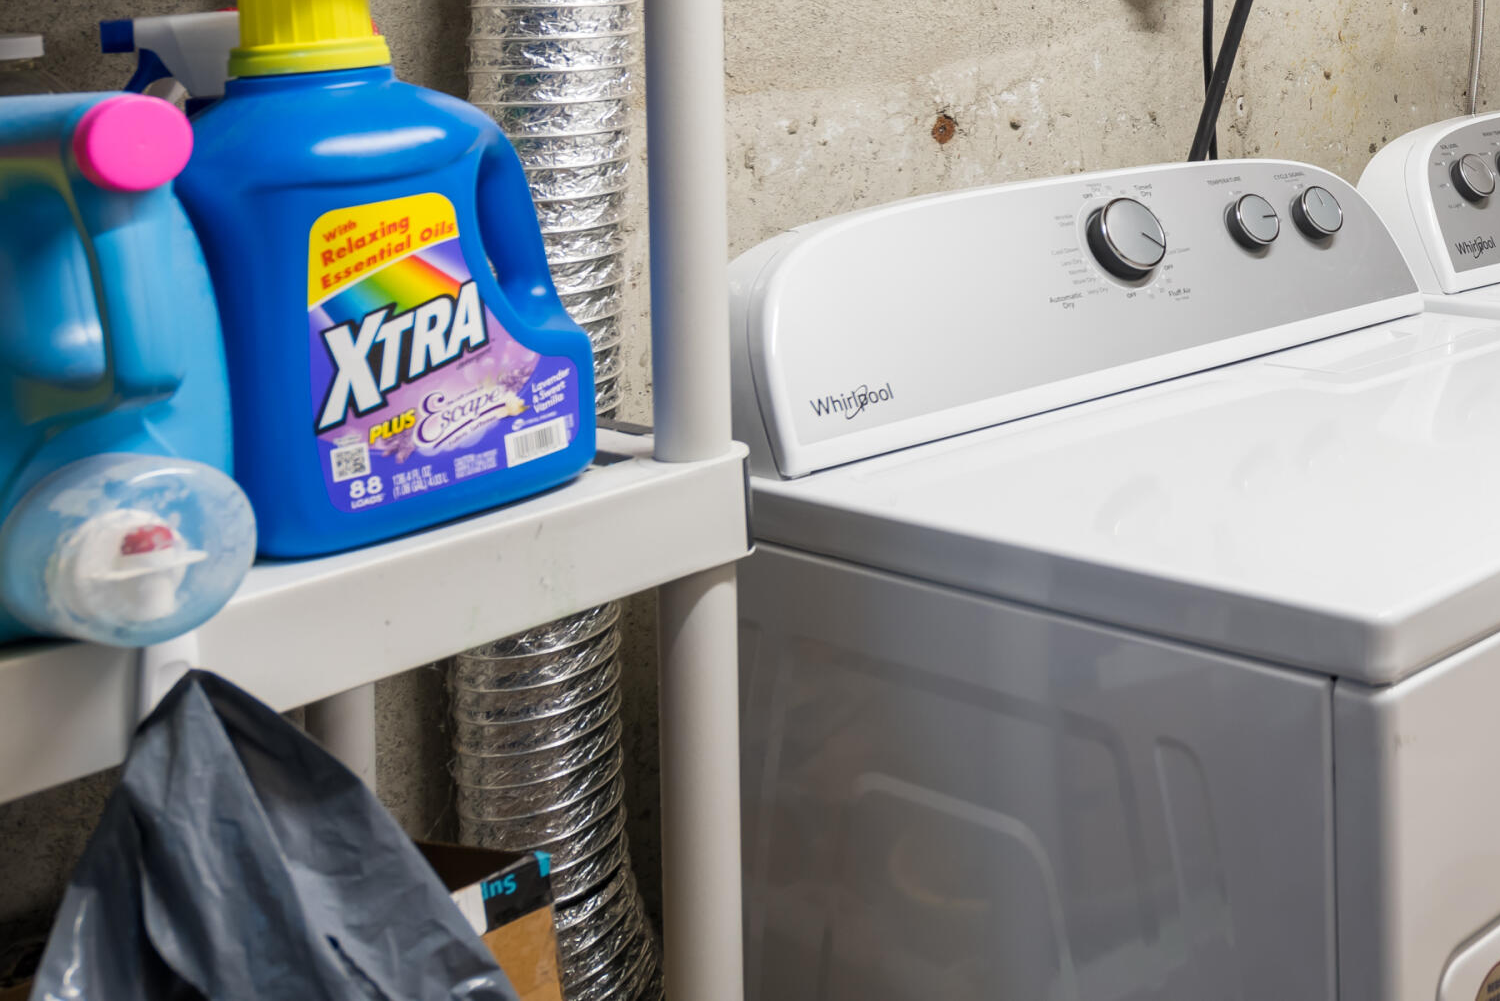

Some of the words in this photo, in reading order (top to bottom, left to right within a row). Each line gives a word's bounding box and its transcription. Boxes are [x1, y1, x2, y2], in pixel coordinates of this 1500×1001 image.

[320, 216, 410, 268] Relaxing
[322, 219, 358, 243] With
[1454, 235, 1497, 259] Whirlpool
[320, 234, 412, 291] Essential
[419, 220, 456, 243] Oils
[316, 280, 489, 433] XTRA
[531, 367, 571, 394] Lavender
[416, 388, 501, 445] Escape
[809, 382, 894, 419] Whirlpool
[368, 408, 417, 445] PLUS
[349, 474, 384, 499] 88
